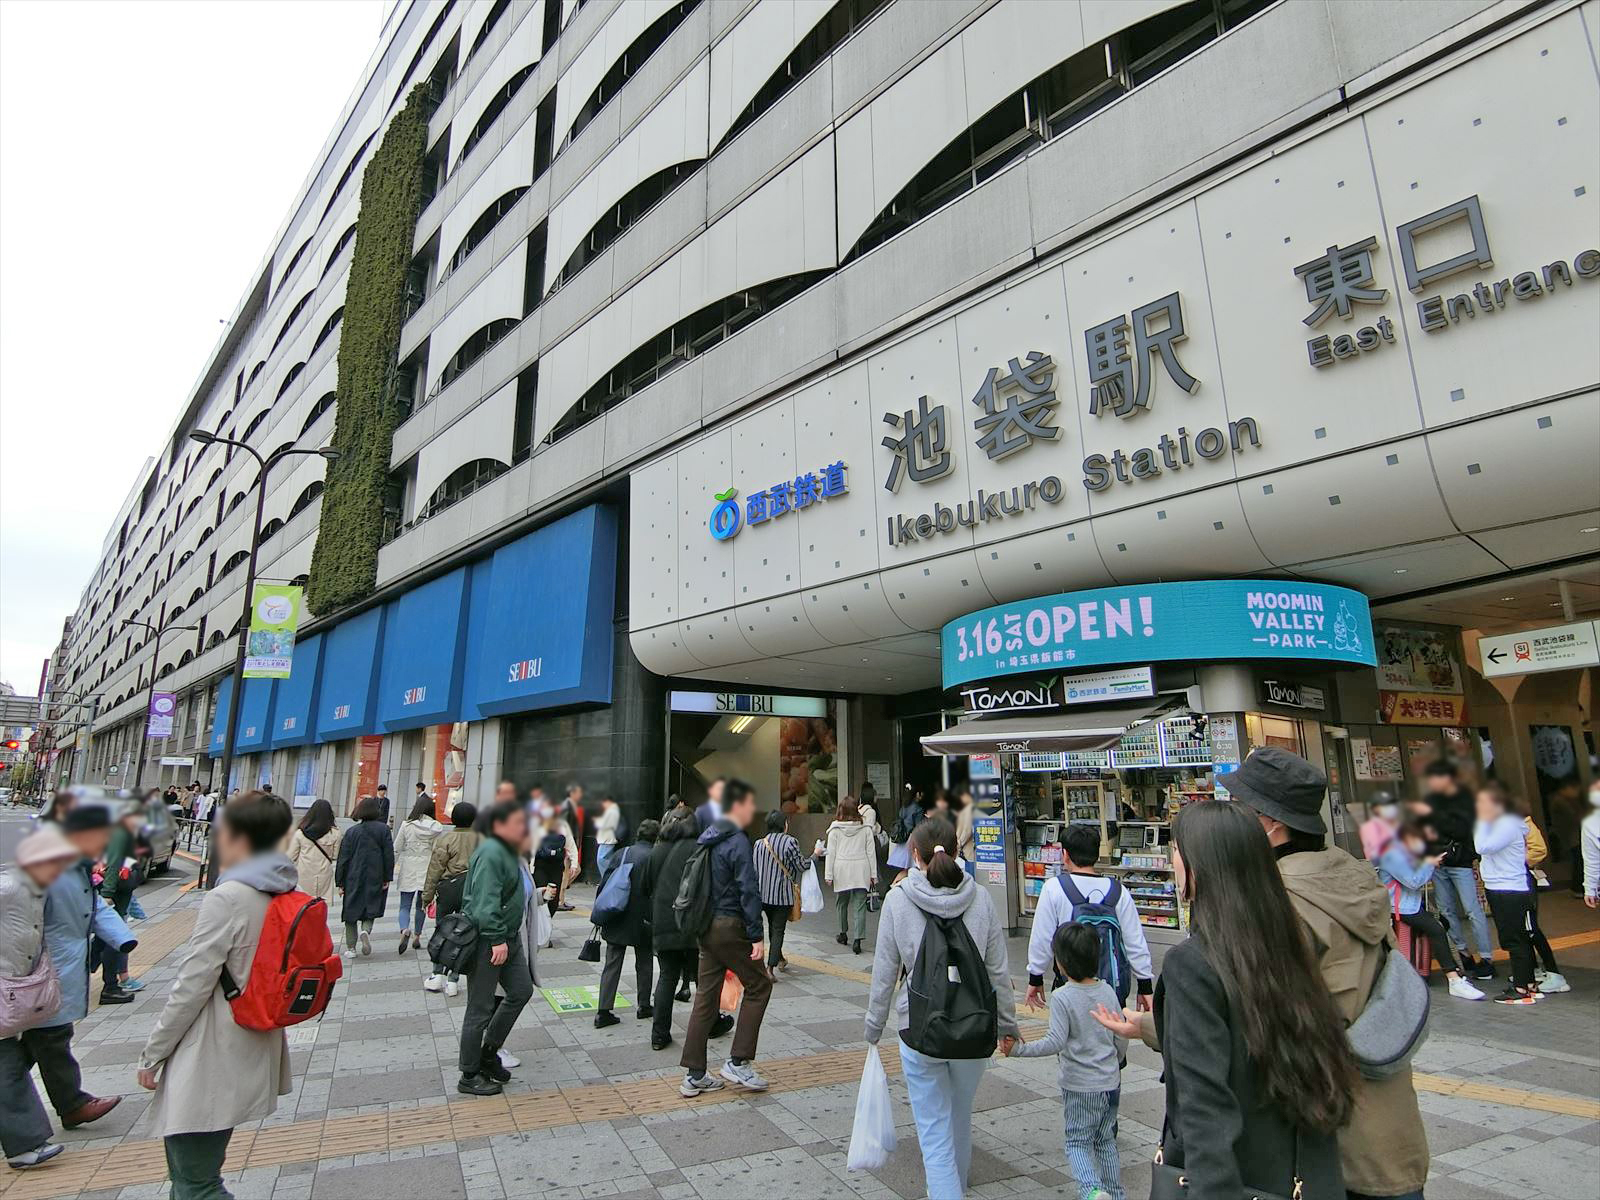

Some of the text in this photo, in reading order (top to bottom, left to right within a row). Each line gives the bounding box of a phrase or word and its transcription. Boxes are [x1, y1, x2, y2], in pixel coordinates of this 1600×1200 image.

[881, 194, 1494, 494] 池袋駅 東口
[1307, 316, 1396, 368] East
[887, 414, 1262, 547] Ikebukuro Station
[746, 459, 849, 527] 西武鉄道
[1247, 592, 1324, 612] MOOMIN
[957, 596, 1154, 662] 3.16 SAT OPEN!
[1249, 612, 1324, 631] VALLEY
[1269, 633, 1317, 648] PARK
[995, 649, 1076, 669] in 埼玉県飯能市
[508, 657, 542, 683] SEIBU
[403, 686, 426, 706] SEIBU
[1113, 685, 1146, 693] FamilyMart
[333, 704, 350, 720] SEIBU
[1216, 742, 1232, 750] 6:30
[1215, 755, 1237, 763] 23:00
